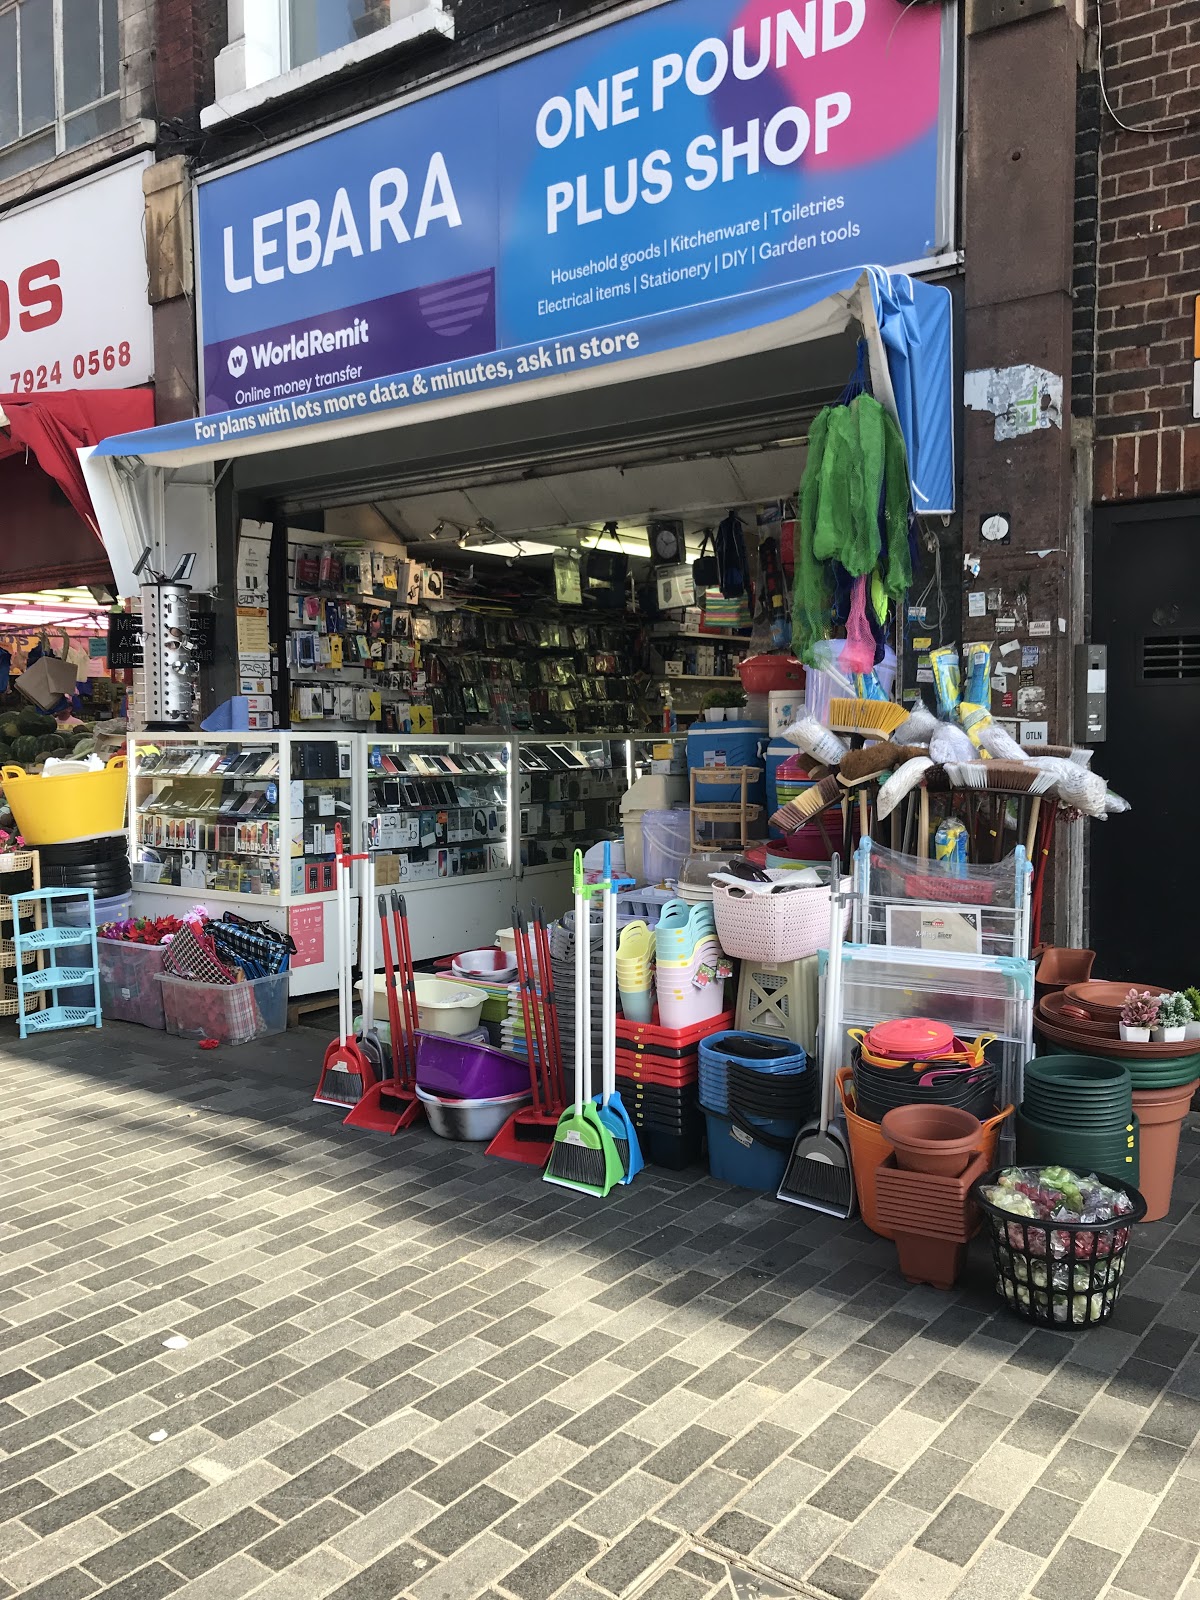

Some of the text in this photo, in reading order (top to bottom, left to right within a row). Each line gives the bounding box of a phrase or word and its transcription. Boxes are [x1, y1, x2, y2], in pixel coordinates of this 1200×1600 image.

[535, 0, 866, 149] ONE POUND
[547, 91, 851, 234] PLUS SHOP
[224, 152, 462, 293] LEBARA
[537, 288, 593, 316] Electrical
[595, 280, 631, 300] items
[640, 260, 711, 290] Stationery
[722, 248, 748, 270] DIY
[759, 234, 817, 260] Garden
[820, 220, 861, 244] tools
[551, 253, 618, 285] Household
[620, 242, 661, 271] goods
[670, 217, 760, 253] Kitchenware
[771, 194, 845, 226] Toiletries
[10, 341, 131, 393] 7924 0568
[195, 332, 640, 440] For plans with lots more data & minutes, ask in store
[235, 364, 363, 405] Online money transfer
[251, 317, 369, 370] WorldRemit
[1025, 731, 1043, 740] OTLN
